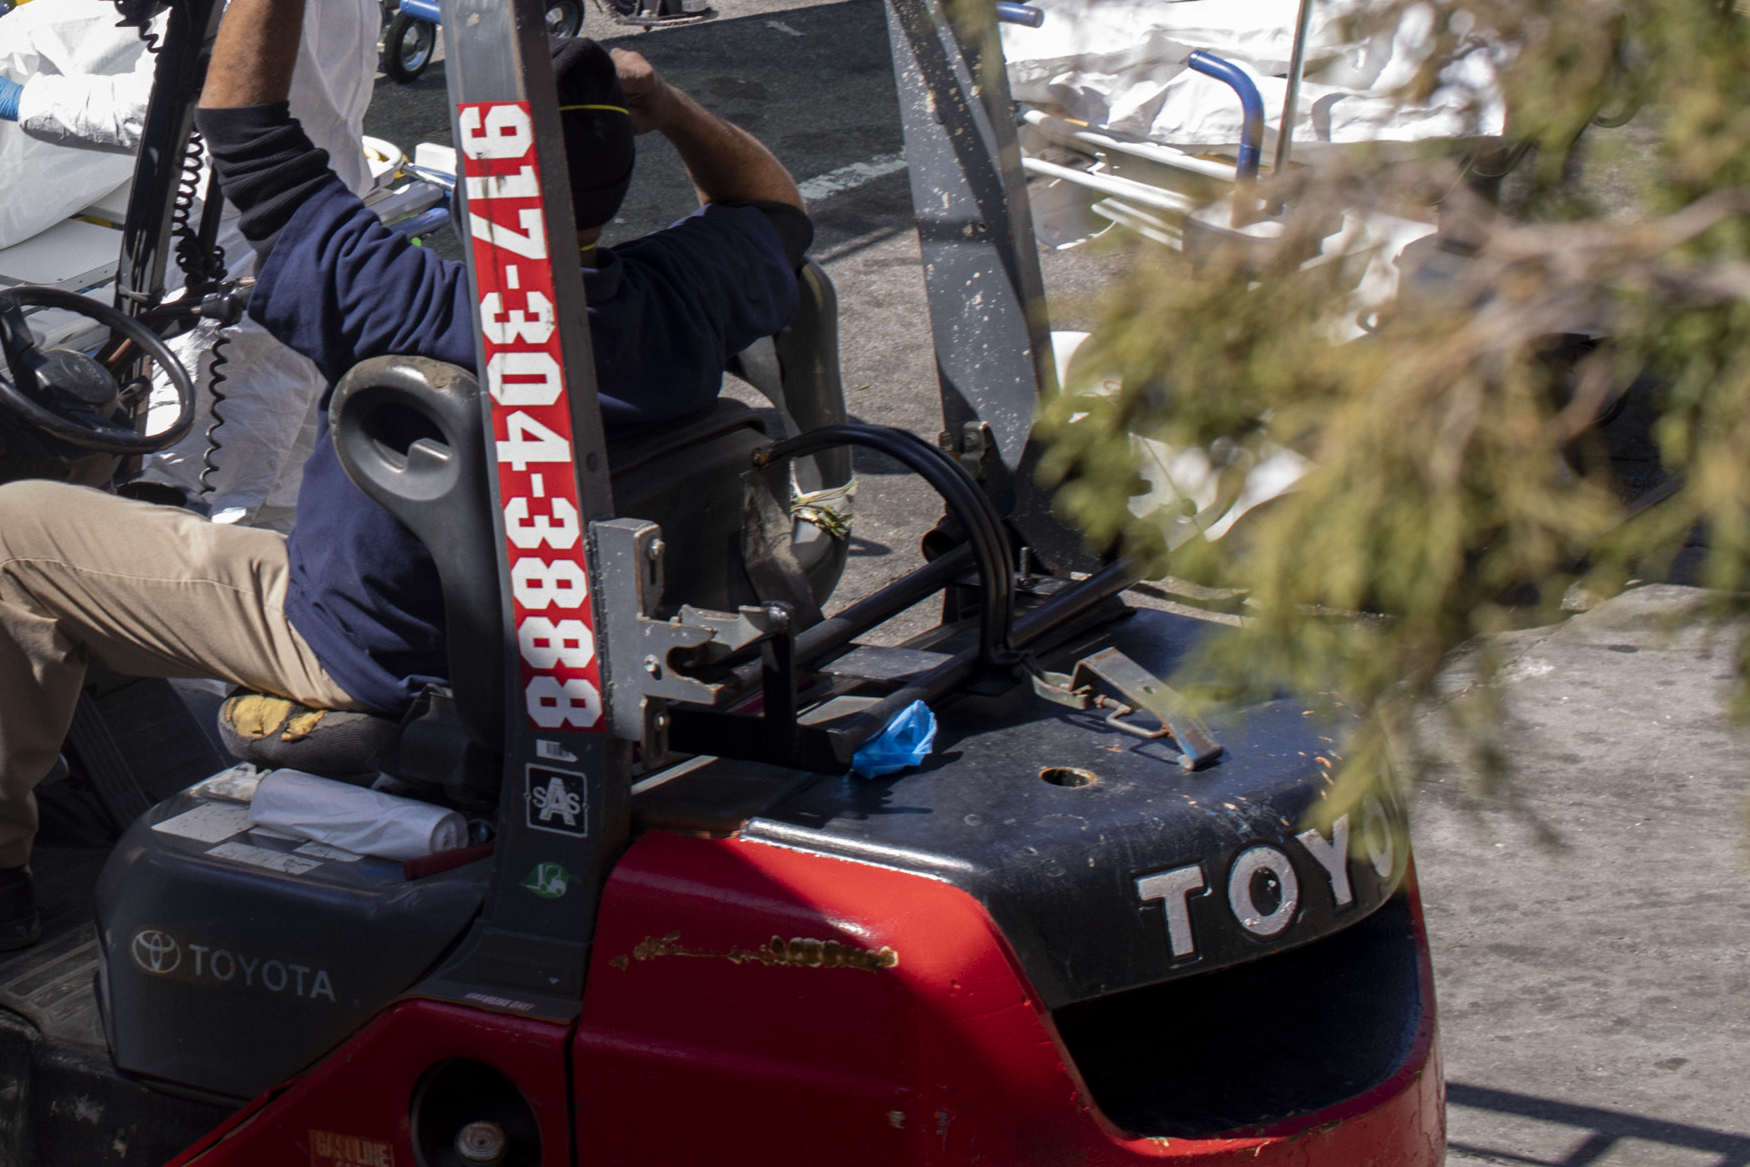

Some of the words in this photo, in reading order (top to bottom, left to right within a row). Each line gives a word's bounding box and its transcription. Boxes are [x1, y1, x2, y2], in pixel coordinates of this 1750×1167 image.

[460, 103, 603, 730] 917-304-3888
[188, 944, 337, 1003] TOYOTA
[314, 1130, 390, 1167] GASOLINE
